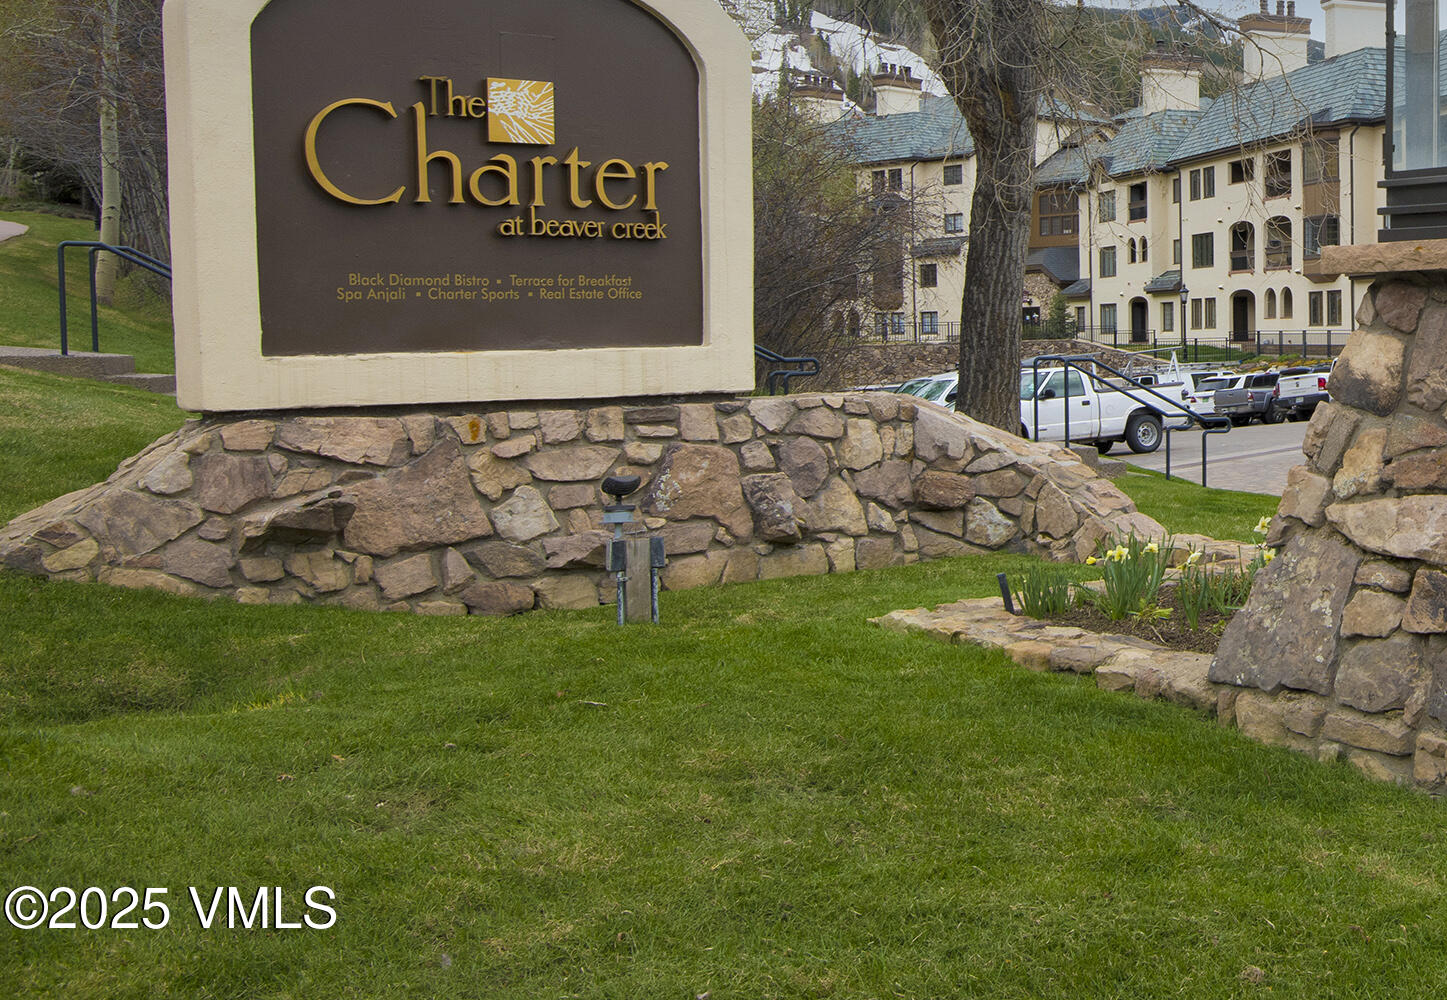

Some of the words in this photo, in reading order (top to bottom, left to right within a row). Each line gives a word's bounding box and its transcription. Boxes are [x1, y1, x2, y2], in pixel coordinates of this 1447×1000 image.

[418, 75, 486, 119] The
[303, 97, 670, 211] Charter
[499, 214, 524, 236] at
[530, 205, 605, 238] beaver
[611, 211, 667, 239] creek
[336, 287, 362, 303] Spa
[367, 287, 406, 302] Anjali
[428, 287, 478, 300] Charter
[481, 288, 520, 302] Sports
[540, 287, 565, 299] Real
[569, 288, 604, 300] Estate
[607, 288, 643, 300] Office
[349, 273, 385, 286] Black
[389, 273, 450, 286] Diamond
[454, 274, 490, 286] Bistro
[509, 274, 554, 287] Terrace
[557, 274, 575, 286] for
[578, 274, 632, 287] Breakfast
